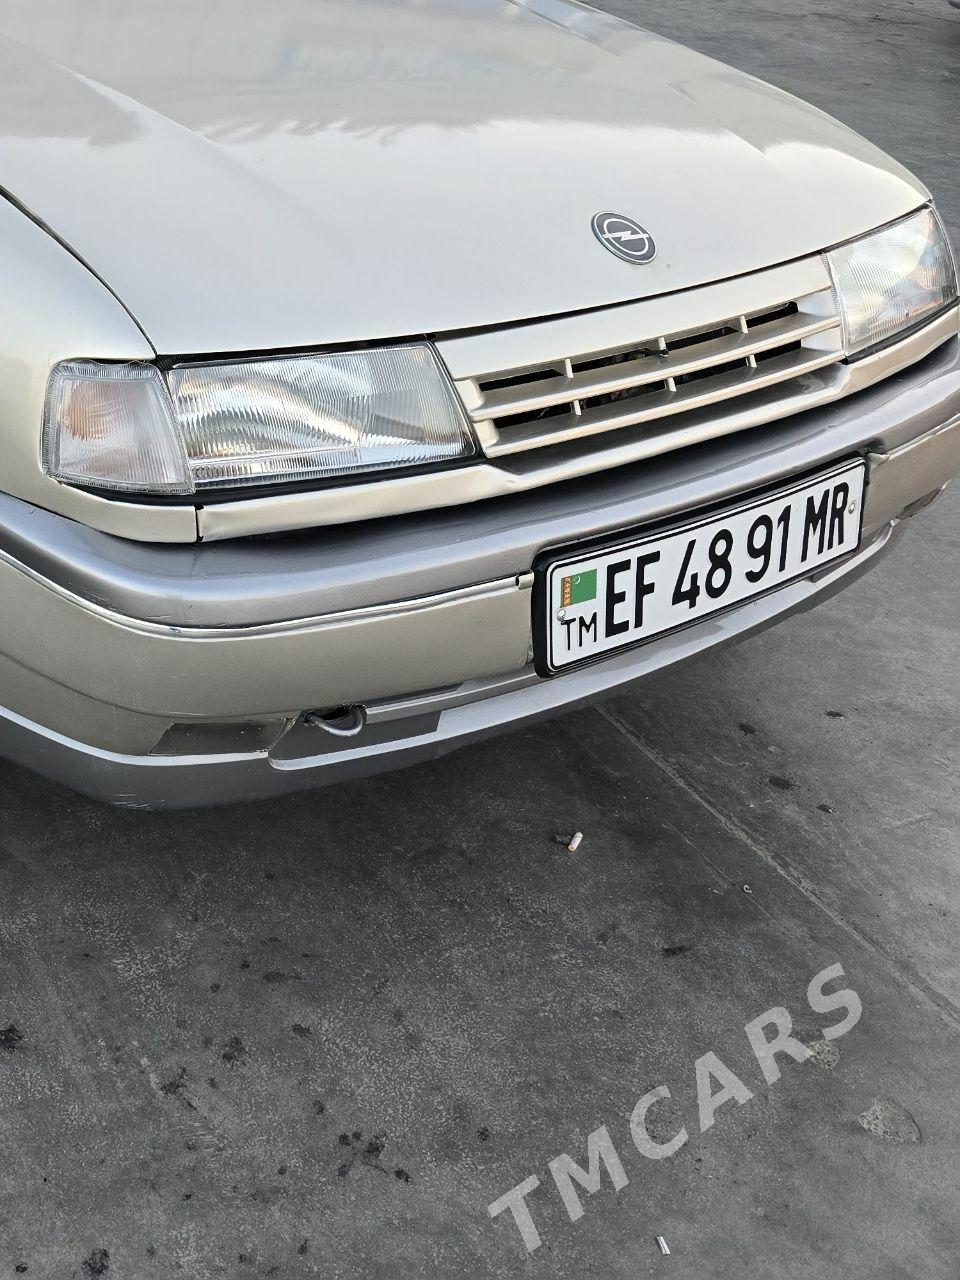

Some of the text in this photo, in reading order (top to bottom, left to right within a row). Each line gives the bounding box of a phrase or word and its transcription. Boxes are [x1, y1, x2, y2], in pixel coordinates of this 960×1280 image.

[604, 550, 661, 638] EF
[801, 482, 850, 563] MR
[561, 611, 597, 651] TM
